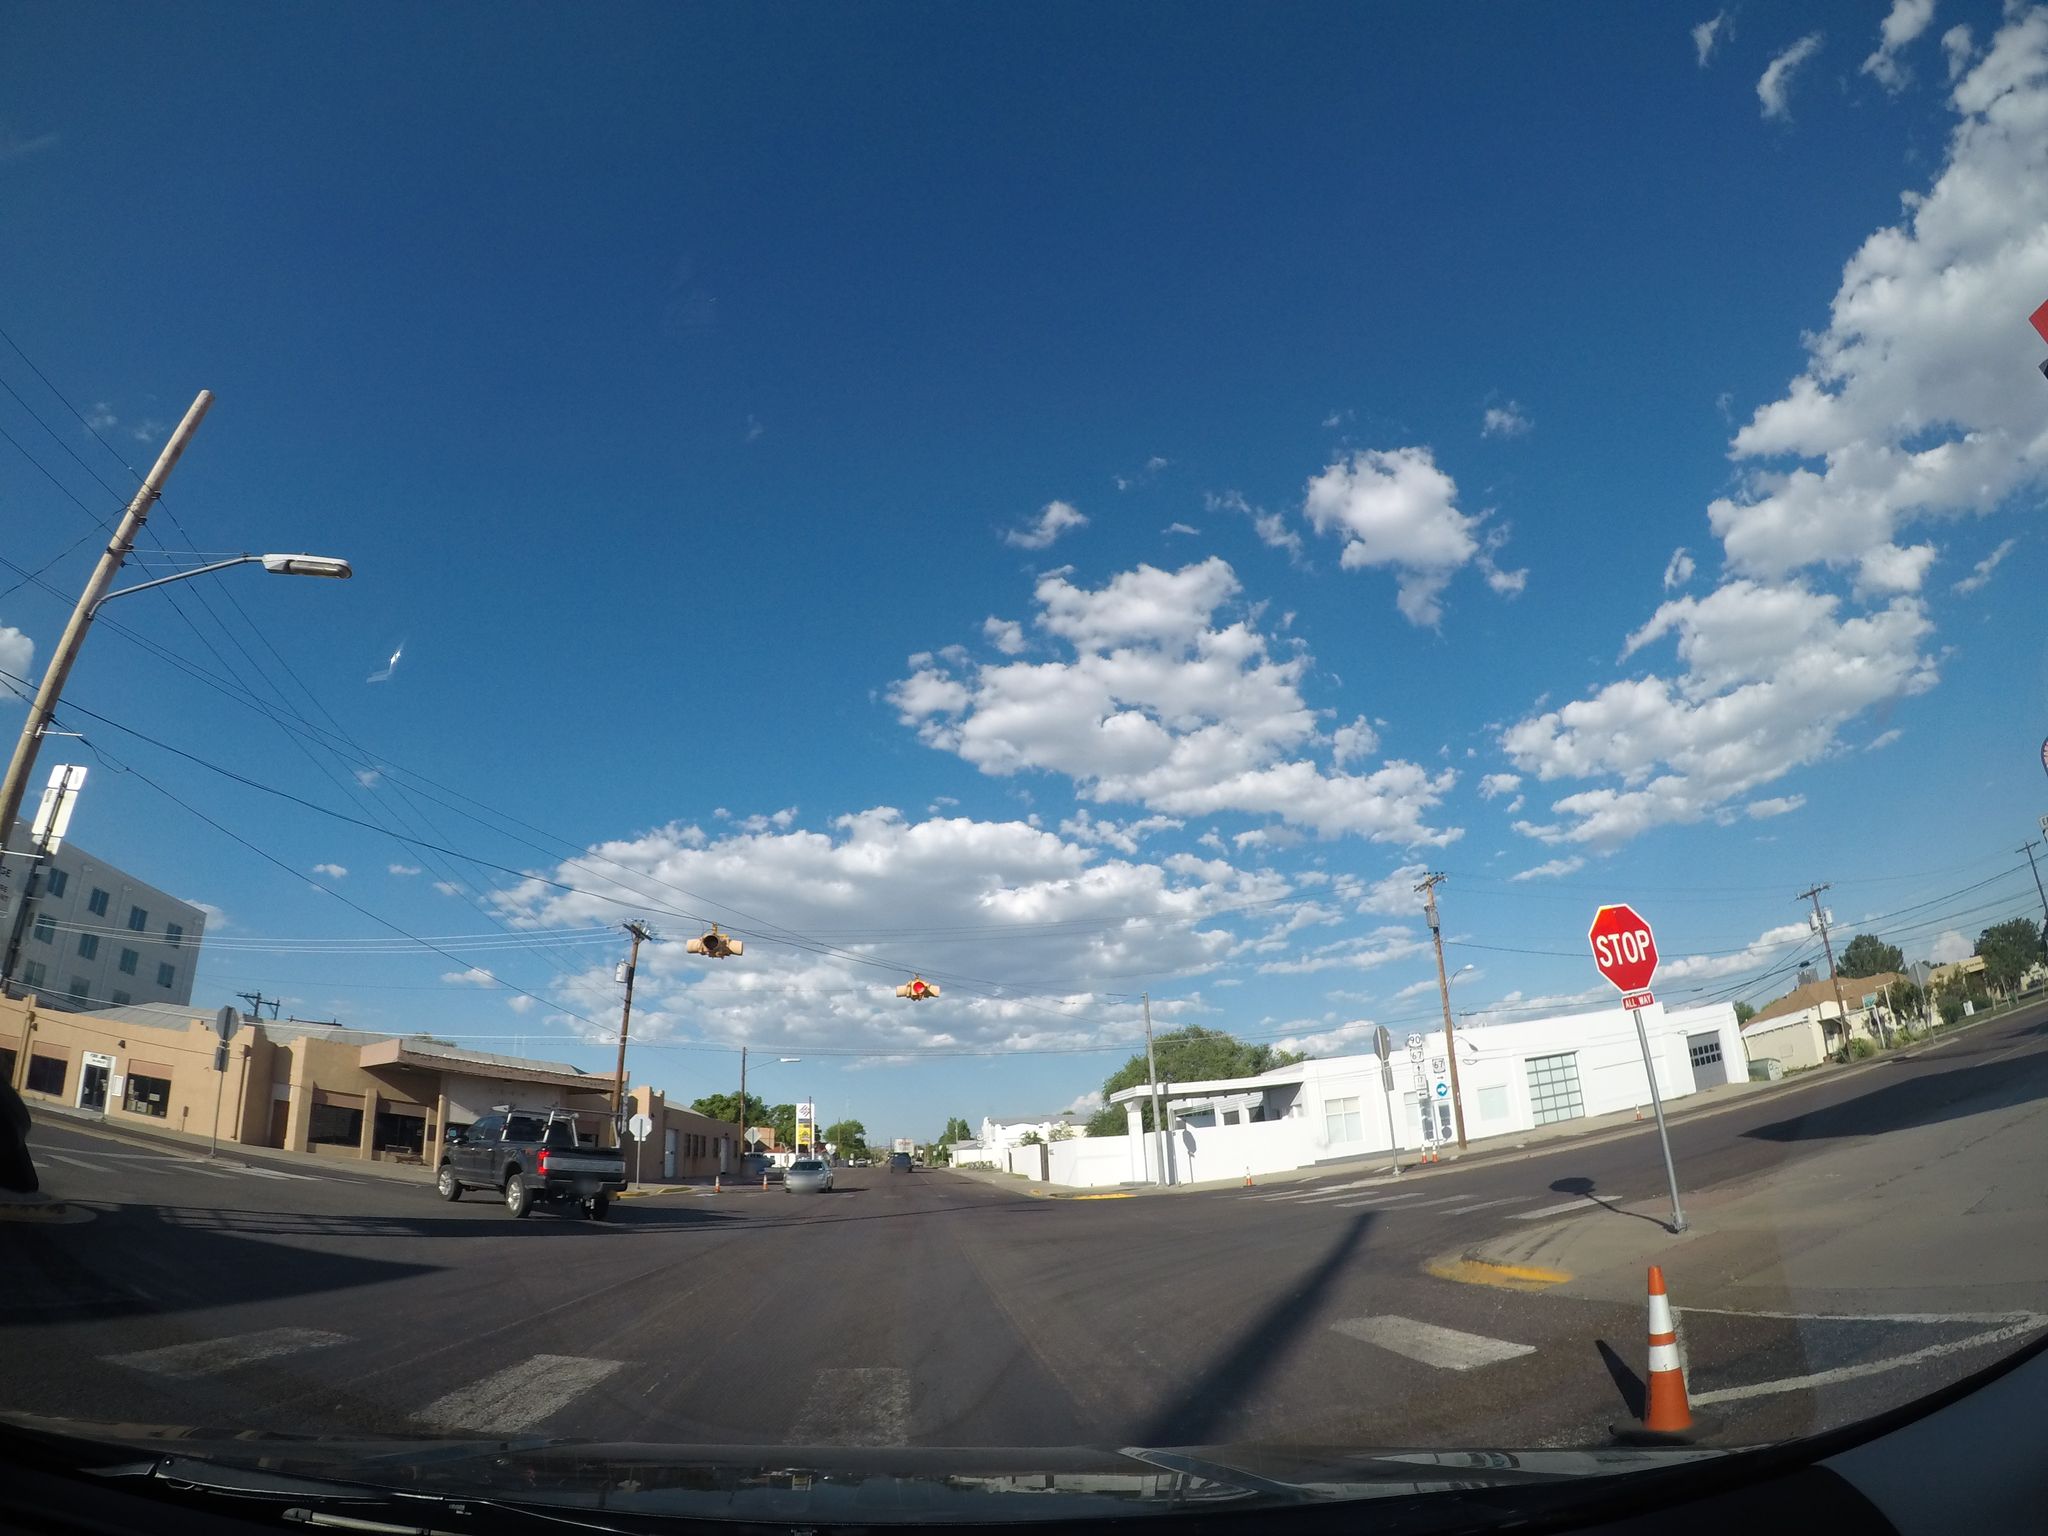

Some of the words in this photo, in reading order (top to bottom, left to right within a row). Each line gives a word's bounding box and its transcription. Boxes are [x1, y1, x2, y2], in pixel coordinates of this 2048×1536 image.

[1596, 929, 1650, 968] STOP
[1625, 997, 1638, 1009] ALL
[1638, 993, 1651, 1006] WAY
[1409, 1035, 1421, 1044] 90
[1412, 1050, 1422, 1060] 67
[1434, 1060, 1443, 1069] 67
